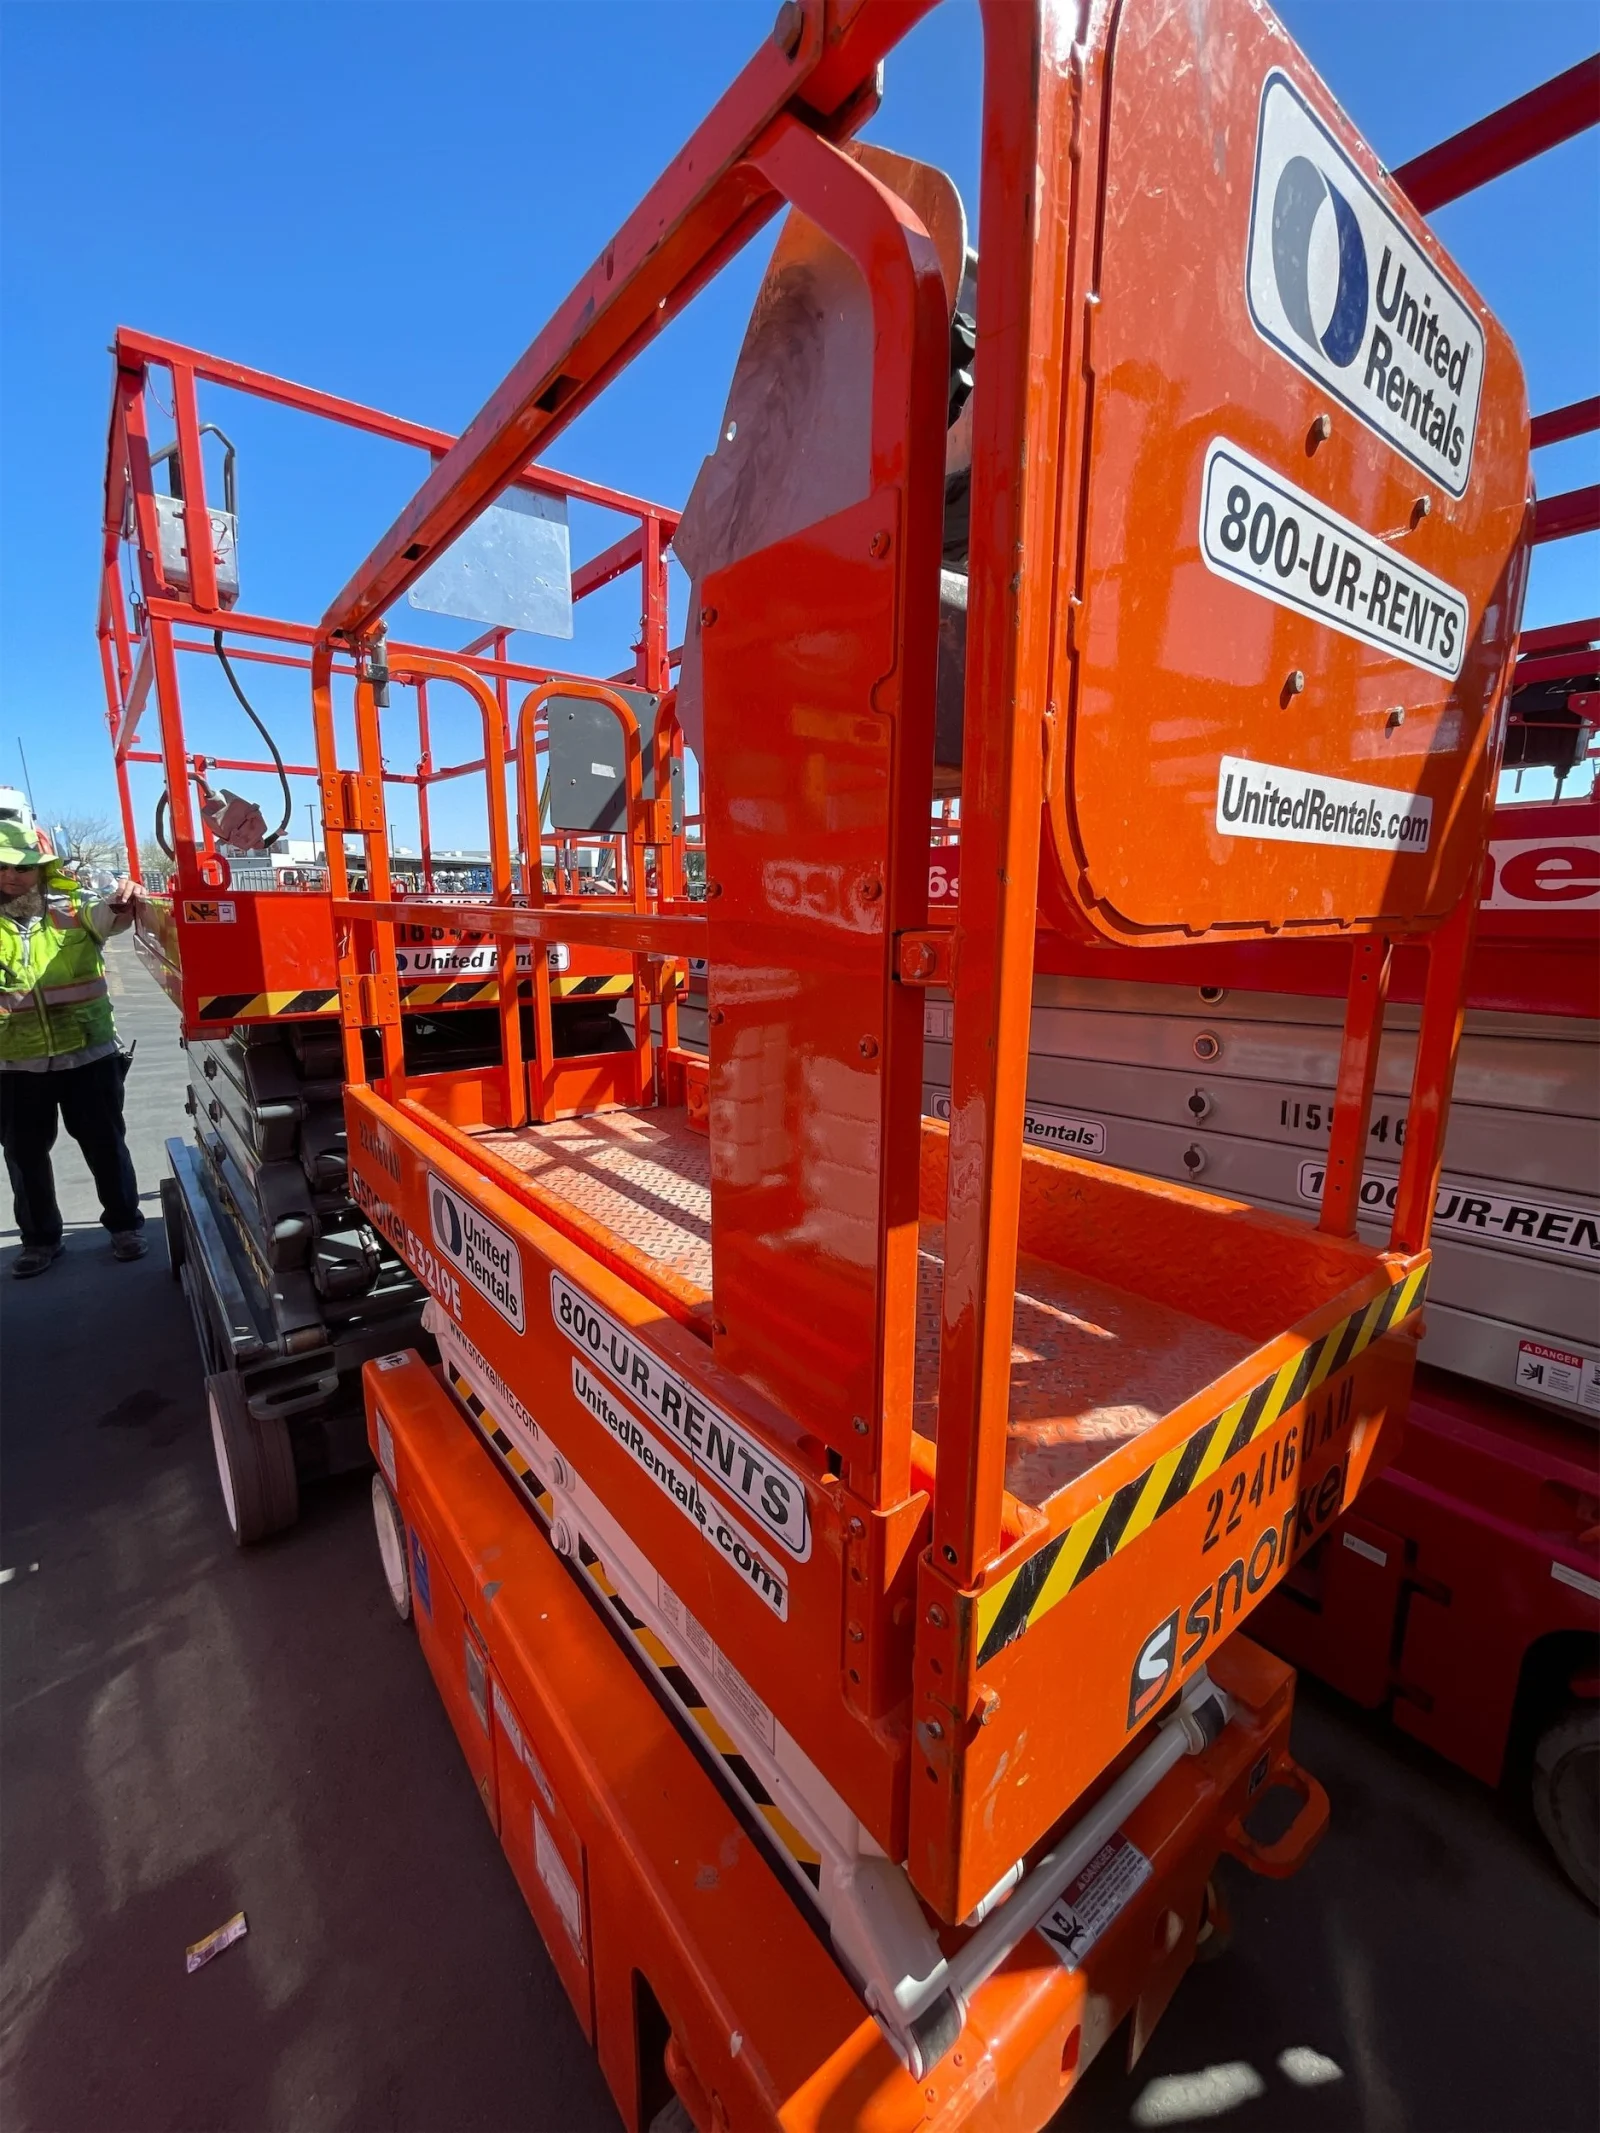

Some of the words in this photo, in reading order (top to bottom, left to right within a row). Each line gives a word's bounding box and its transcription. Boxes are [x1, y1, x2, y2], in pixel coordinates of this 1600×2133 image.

[1376, 245, 1470, 398] United
[1364, 325, 1465, 469] Rentals
[1220, 485, 1458, 659] 800-UR-RENTS
[1223, 775, 1428, 844] UnitedRentals.com
[414, 952, 485, 970] United
[1024, 1118, 1095, 1146] Rentals
[407, 1229, 463, 1322] S3219E
[464, 1212, 510, 1278] United
[466, 1243, 518, 1317] Rentals
[1534, 1346, 1579, 1366] DANGER
[560, 1292, 791, 1526] 800-UR-RENTS
[575, 1368, 783, 1608] UnitedRentals.com
[1182, 1447, 1352, 1670] snorkel
[1083, 1843, 1117, 1884] DANGER
